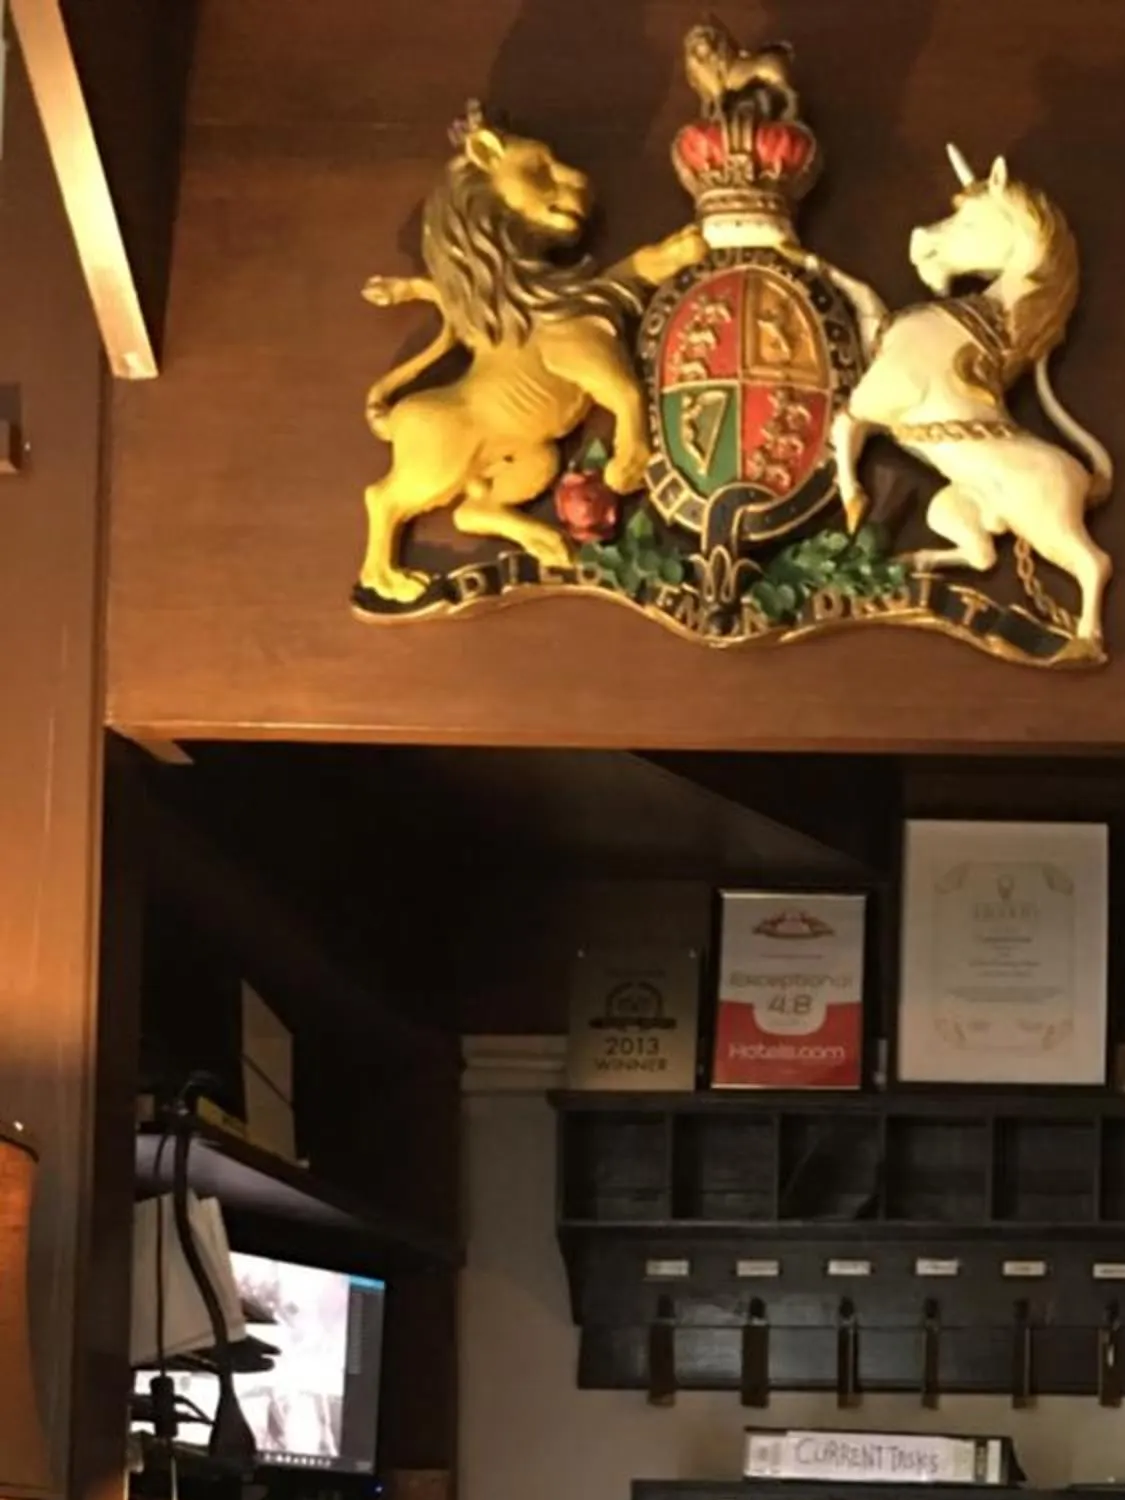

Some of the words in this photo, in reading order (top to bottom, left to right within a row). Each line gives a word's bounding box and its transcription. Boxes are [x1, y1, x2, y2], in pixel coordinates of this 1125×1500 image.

[604, 1036, 660, 1056] 2013
[729, 1042, 846, 1065] Hotels.com
[594, 1058, 668, 1072] WINNER
